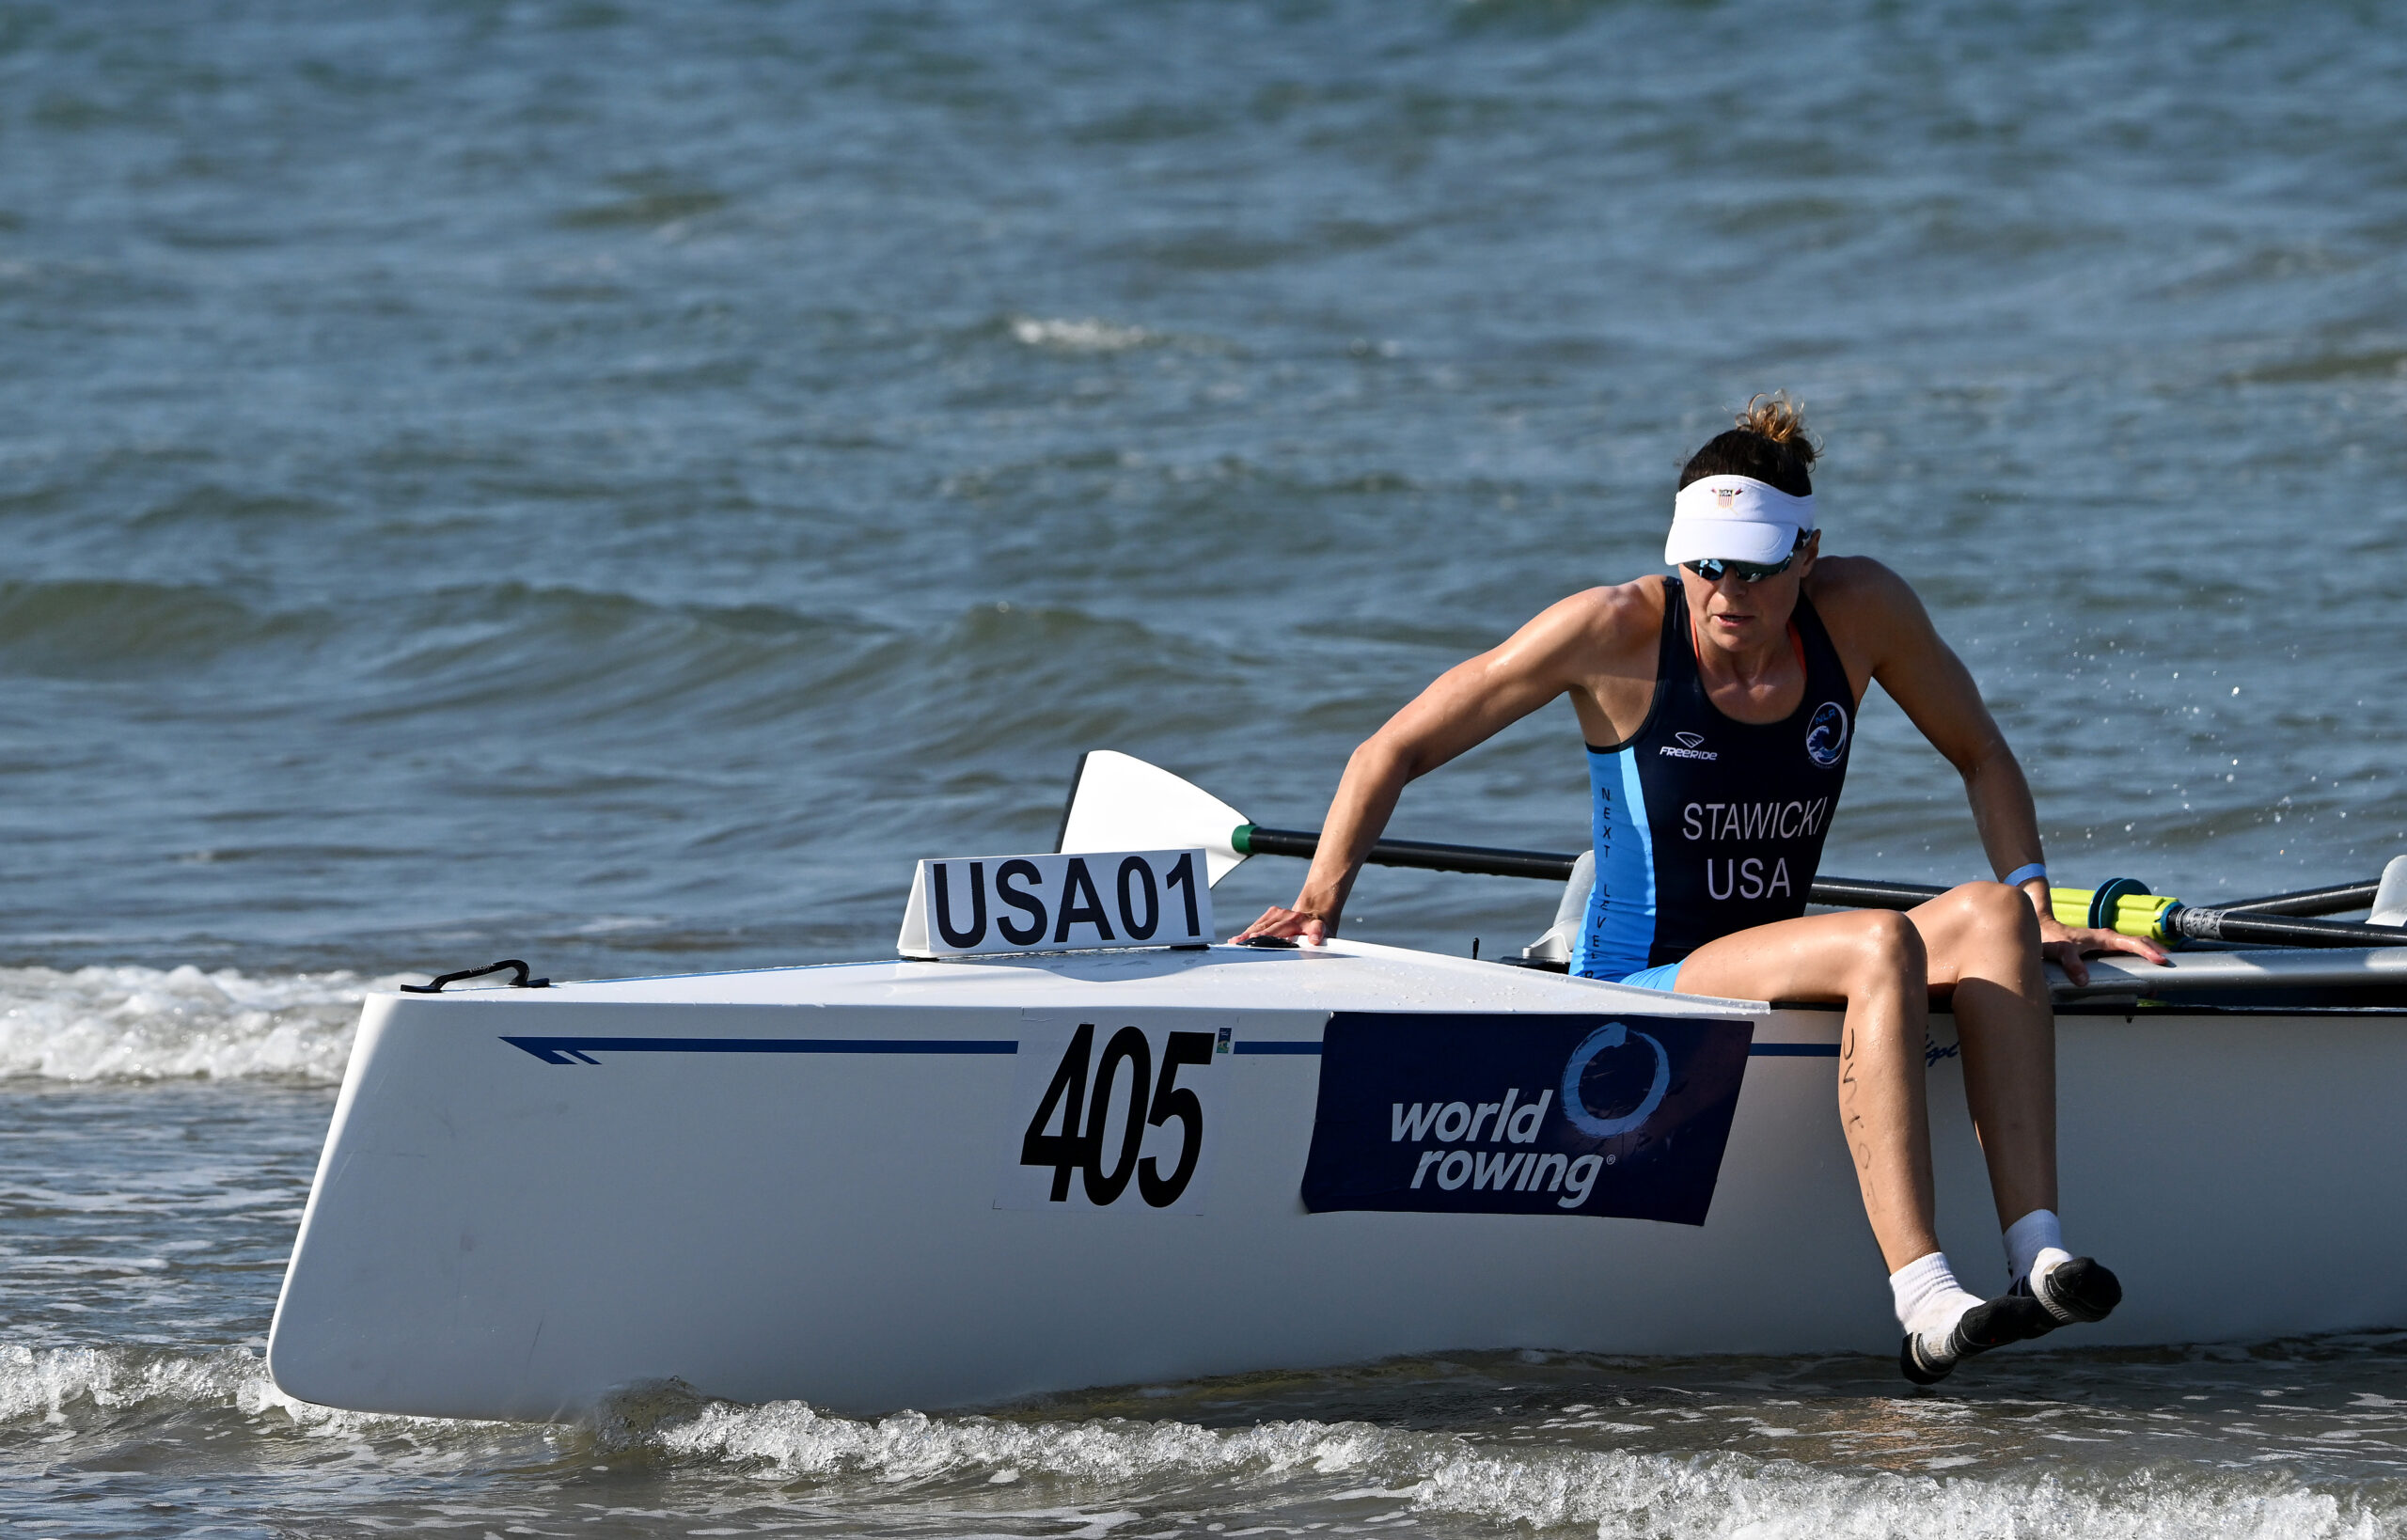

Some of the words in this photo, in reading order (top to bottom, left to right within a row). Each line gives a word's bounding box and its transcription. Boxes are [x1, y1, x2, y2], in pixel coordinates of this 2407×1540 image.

[1660, 746, 1718, 761] FREERIDE
[1601, 787, 1612, 858] NEXT
[1682, 796, 1828, 841] STAWICKI
[933, 852, 1201, 949] USA01
[1707, 857, 1791, 900] USA
[1020, 1023, 1216, 1208] 405
[1392, 1088, 1553, 1144] world
